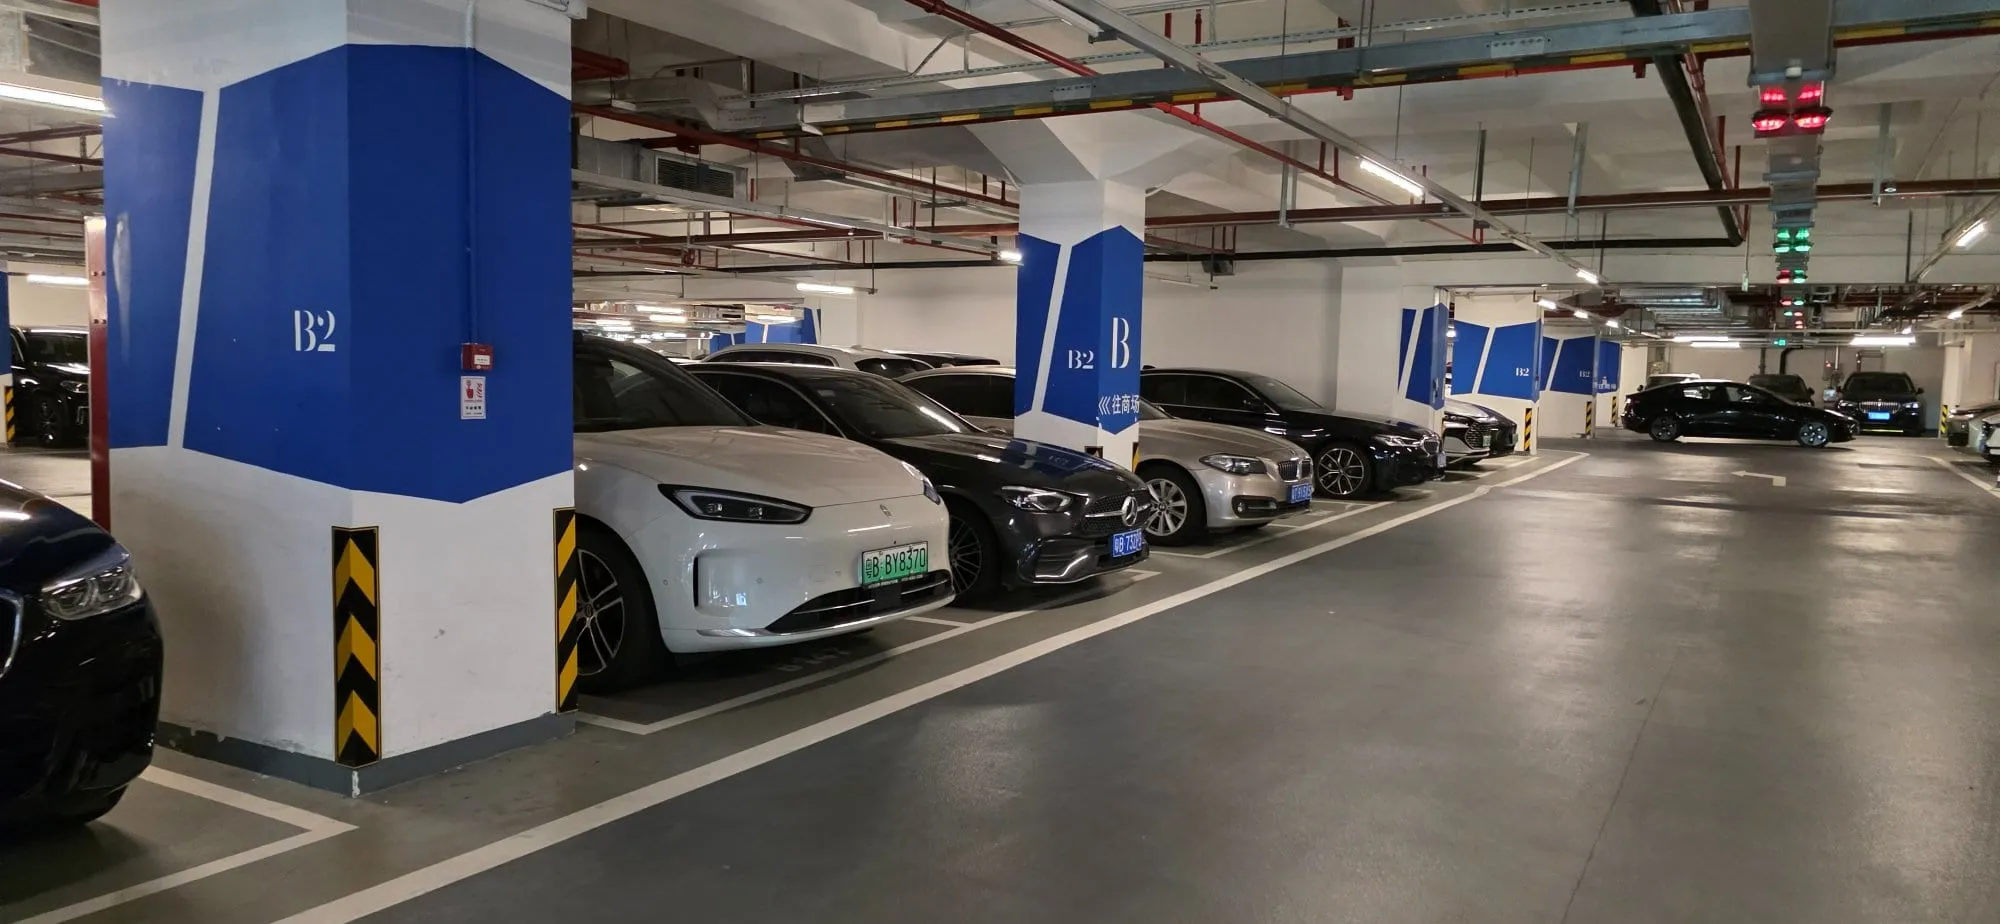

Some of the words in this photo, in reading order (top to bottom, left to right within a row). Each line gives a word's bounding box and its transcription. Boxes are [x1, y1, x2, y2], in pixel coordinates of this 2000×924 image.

[294, 310, 336, 352] B2
[1111, 317, 1130, 369] B
[1068, 350, 1094, 369] B2
[1515, 367, 1530, 377] B2
[1112, 393, 1140, 415] 往商场
